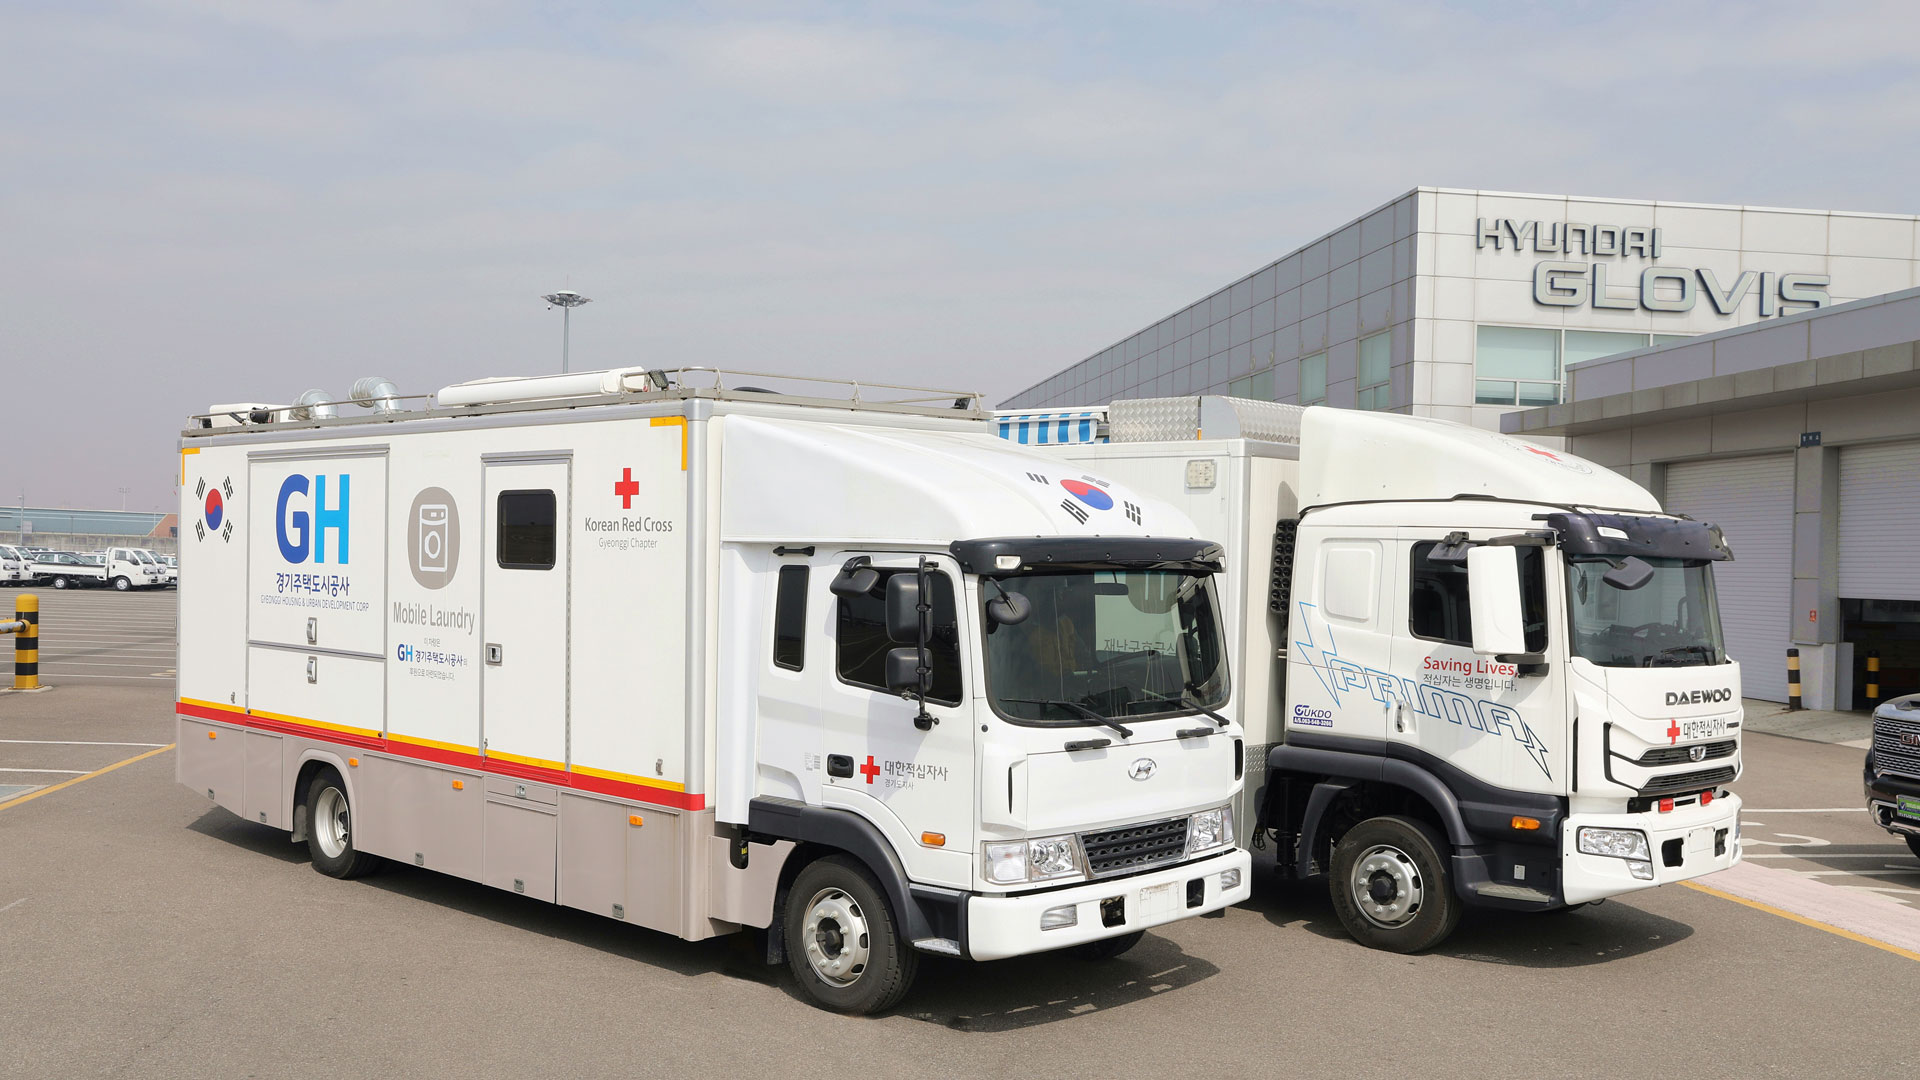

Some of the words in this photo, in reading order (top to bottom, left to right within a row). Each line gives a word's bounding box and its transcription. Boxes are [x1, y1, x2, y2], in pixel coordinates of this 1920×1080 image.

[1477, 217, 1662, 259] HYUNDAI
[1533, 260, 1831, 318] GLOVIS
[276, 473, 350, 564] GH
[584, 517, 620, 532] Korean
[622, 516, 642, 532] Red
[644, 517, 673, 532] Cross
[598, 537, 630, 551] Gyeonggi
[630, 537, 658, 550] Chapter
[276, 572, 350, 597] 경기주택도시공사
[322, 599, 355, 611] DEVELOPMENT
[393, 601, 427, 626] Mobile
[430, 603, 475, 636] Laundry
[397, 643, 414, 662] GH
[1423, 656, 1472, 676] Saving
[1476, 659, 1519, 678] Lives,
[1423, 673, 1461, 688] 적십자는
[1464, 676, 1518, 692] 생명입니다.
[1329, 658, 1530, 744] PRIMA
[1665, 687, 1732, 706] DAEWOO
[1683, 717, 1726, 740] 대한적십자사
[884, 760, 949, 782] 대한적십자사
